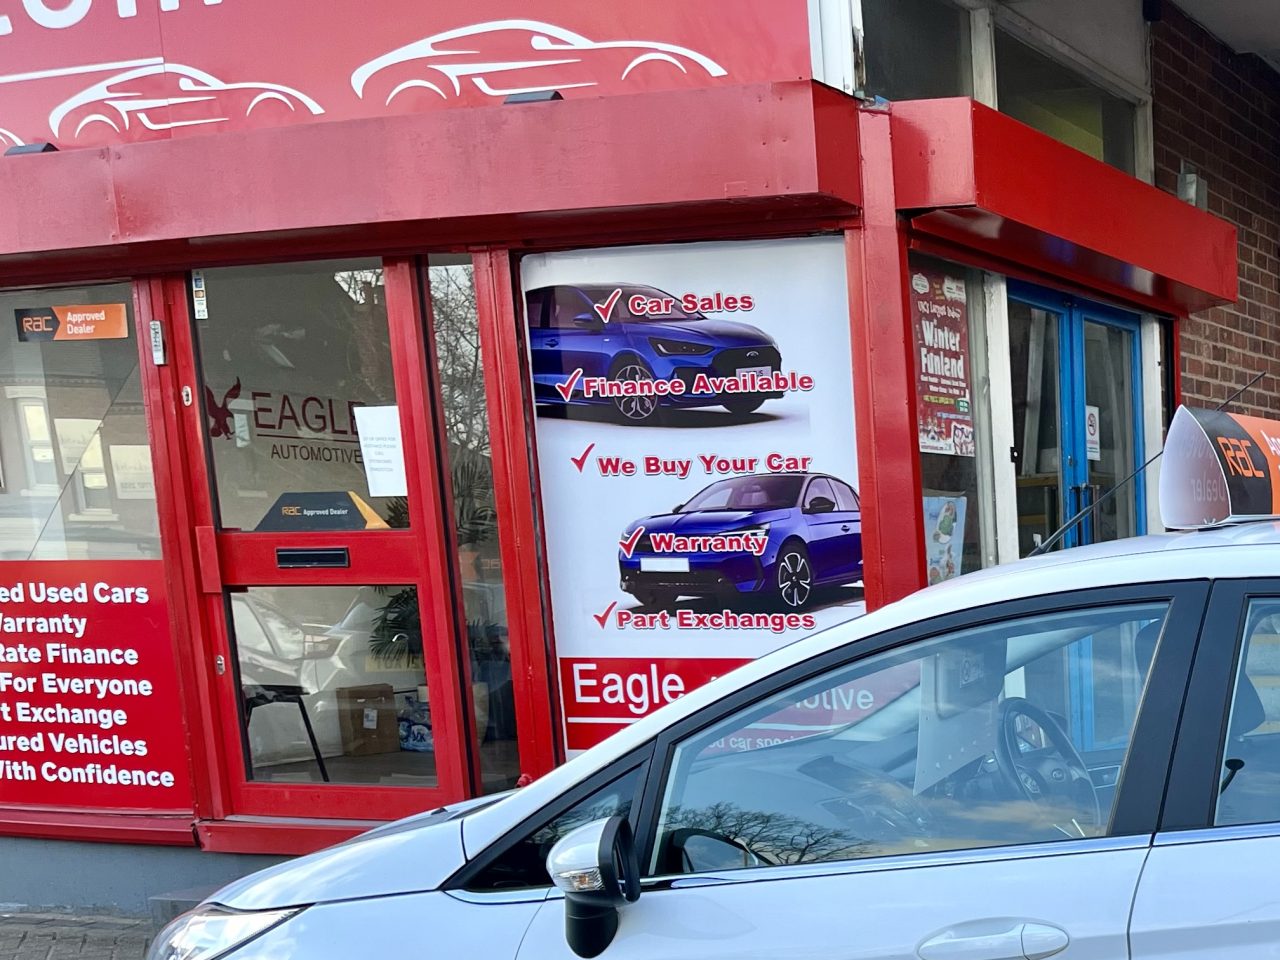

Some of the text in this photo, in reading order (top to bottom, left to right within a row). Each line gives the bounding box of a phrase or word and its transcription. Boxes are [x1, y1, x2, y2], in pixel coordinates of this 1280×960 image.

[628, 292, 754, 315] Car Sales
[66, 310, 106, 323] Approved
[66, 323, 96, 335] Dealer
[921, 319, 960, 351] Winter
[920, 347, 964, 380] Funland
[583, 376, 685, 397] Finance
[692, 372, 814, 395] Available
[270, 443, 363, 464] AUTOMOTIVE
[597, 453, 812, 478] We Buy Your Car
[650, 533, 768, 555] Warranty
[28, 582, 88, 603] Used
[93, 582, 150, 604] Cars
[0, 613, 87, 638] arranty
[616, 610, 816, 632] Part Exchanges
[46, 642, 139, 665] Finance
[0, 672, 153, 699] For Everyone
[572, 663, 685, 714] Eagle
[16, 702, 128, 729] Exchange
[48, 732, 148, 756] Vehicles
[0, 760, 176, 787] ith Confidence
